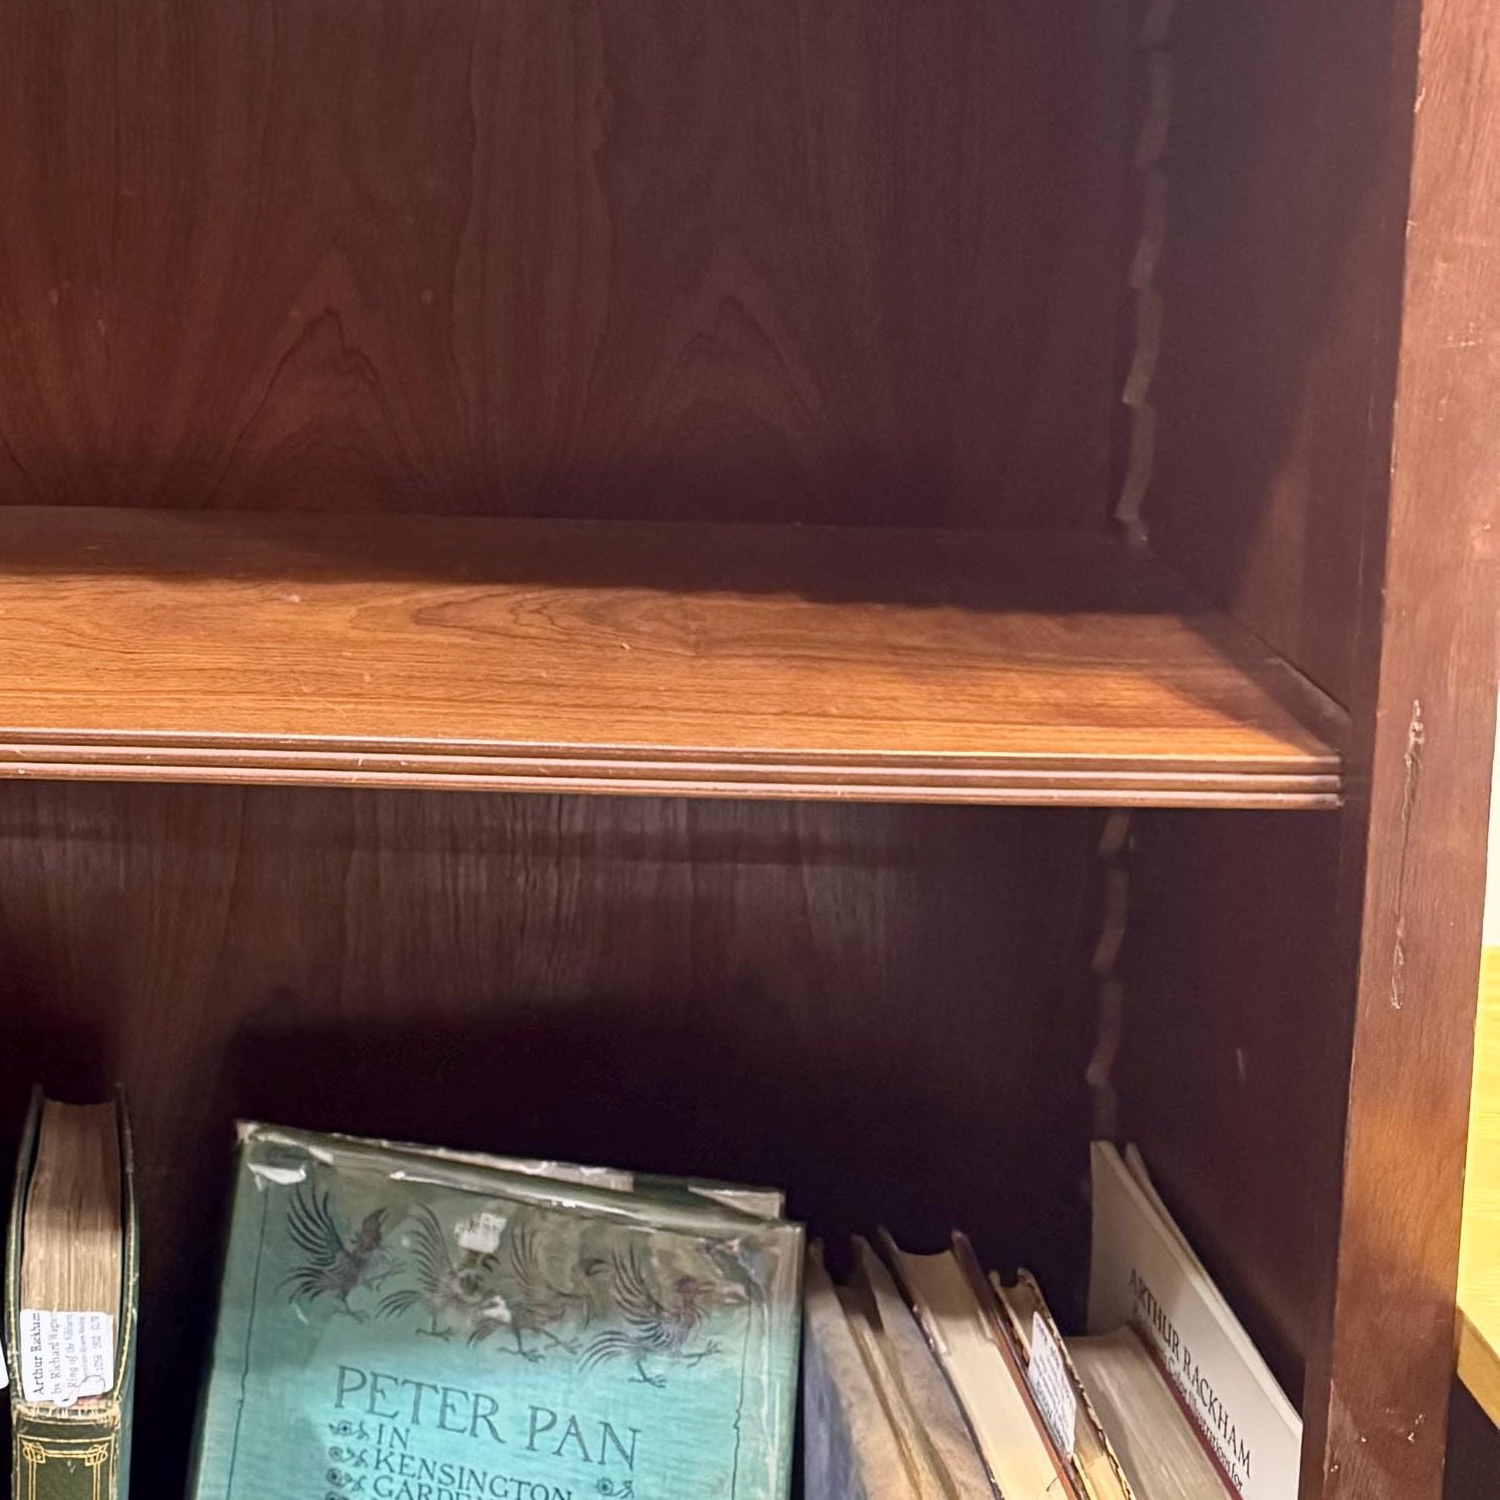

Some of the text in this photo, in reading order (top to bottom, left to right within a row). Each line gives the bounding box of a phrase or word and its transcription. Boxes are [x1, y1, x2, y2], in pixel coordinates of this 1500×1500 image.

[30, 1356, 44, 1395] Arthur
[1127, 1267, 1181, 1361] ARTHUR
[1182, 1349, 1252, 1479] RACKHAM
[333, 1364, 642, 1471] PETER PAN
[376, 1422, 411, 1450] IN
